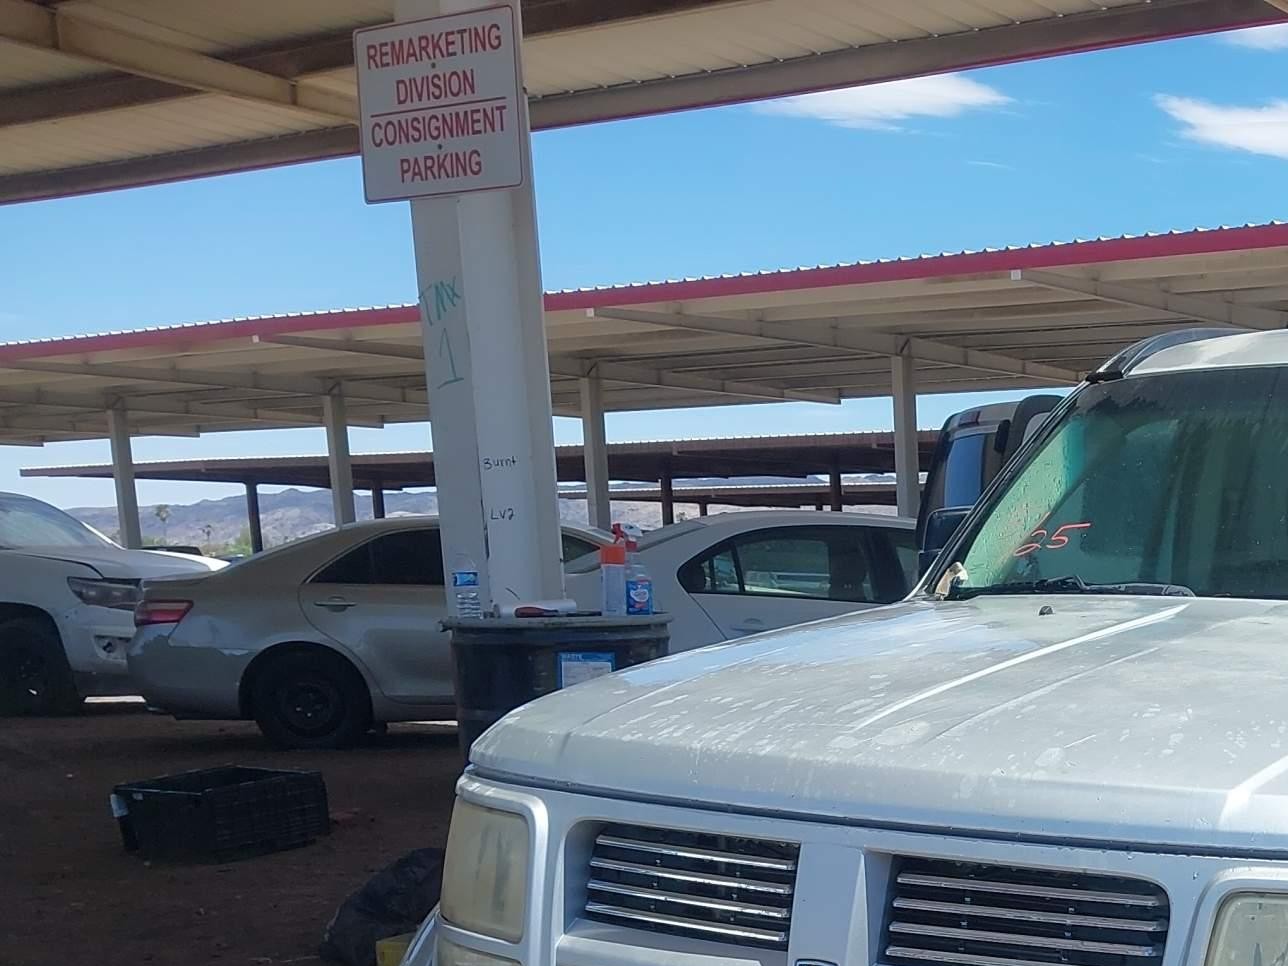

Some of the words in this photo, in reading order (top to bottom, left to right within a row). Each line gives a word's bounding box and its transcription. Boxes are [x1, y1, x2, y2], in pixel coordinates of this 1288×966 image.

[366, 23, 502, 70] REMARKETING
[396, 68, 476, 105] DIVISION
[371, 105, 507, 148] CONSIGNMENT
[400, 149, 482, 184] PARKING
